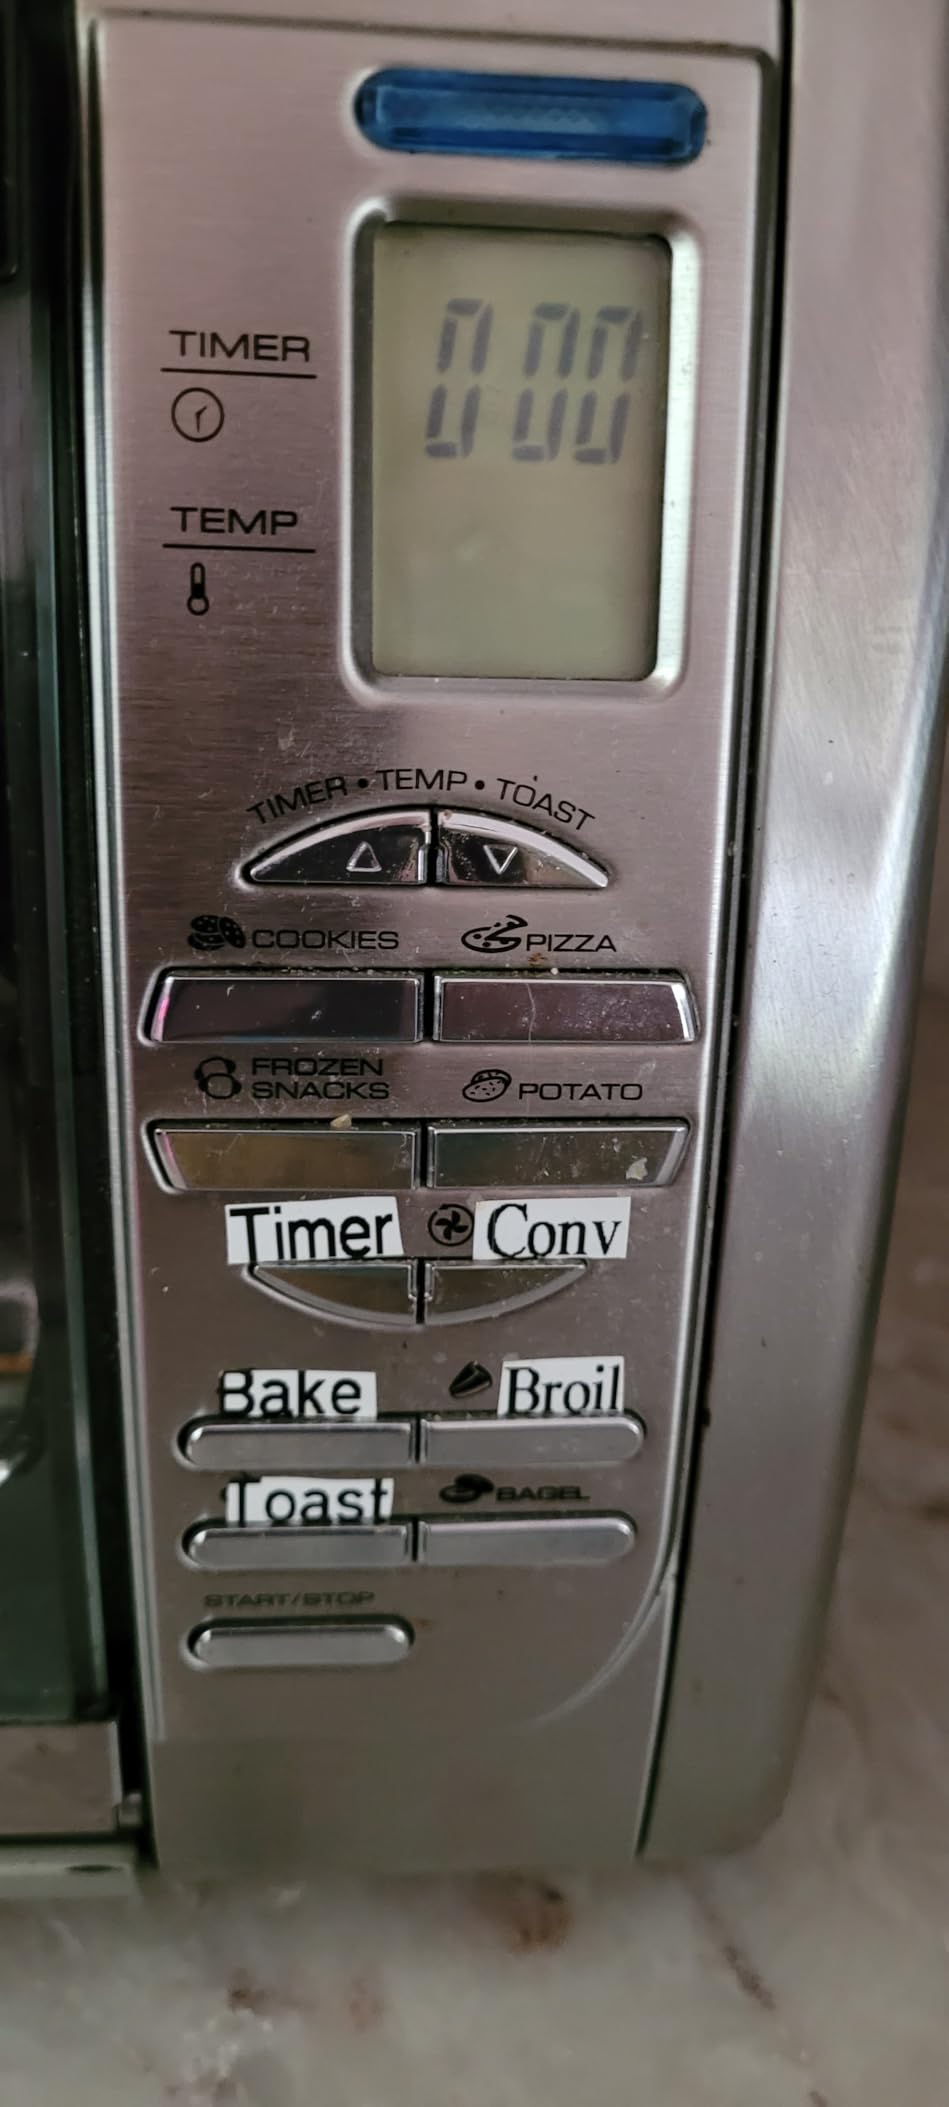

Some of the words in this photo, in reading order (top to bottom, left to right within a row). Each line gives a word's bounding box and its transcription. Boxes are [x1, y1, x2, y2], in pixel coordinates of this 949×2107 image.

[169, 330, 311, 362] TIMER
[170, 507, 299, 535] TEMP
[245, 775, 349, 826] TIMER
[376, 768, 469, 792] TEMP
[496, 778, 596, 832] TOAST
[251, 929, 400, 950] COOKIES
[526, 933, 618, 953] PIZZA
[251, 1058, 384, 1076] FROZEN
[251, 1081, 390, 1101] SNACKS
[518, 1082, 644, 1101] POTATO
[229, 1205, 395, 1263] Timer
[486, 1203, 624, 1259] Conv
[218, 1369, 363, 1418] Bake
[504, 1364, 624, 1414] Broil
[226, 1476, 390, 1524] Toast
[494, 1486, 592, 1502] BAGEL
[204, 1591, 375, 1608] START/STOP
